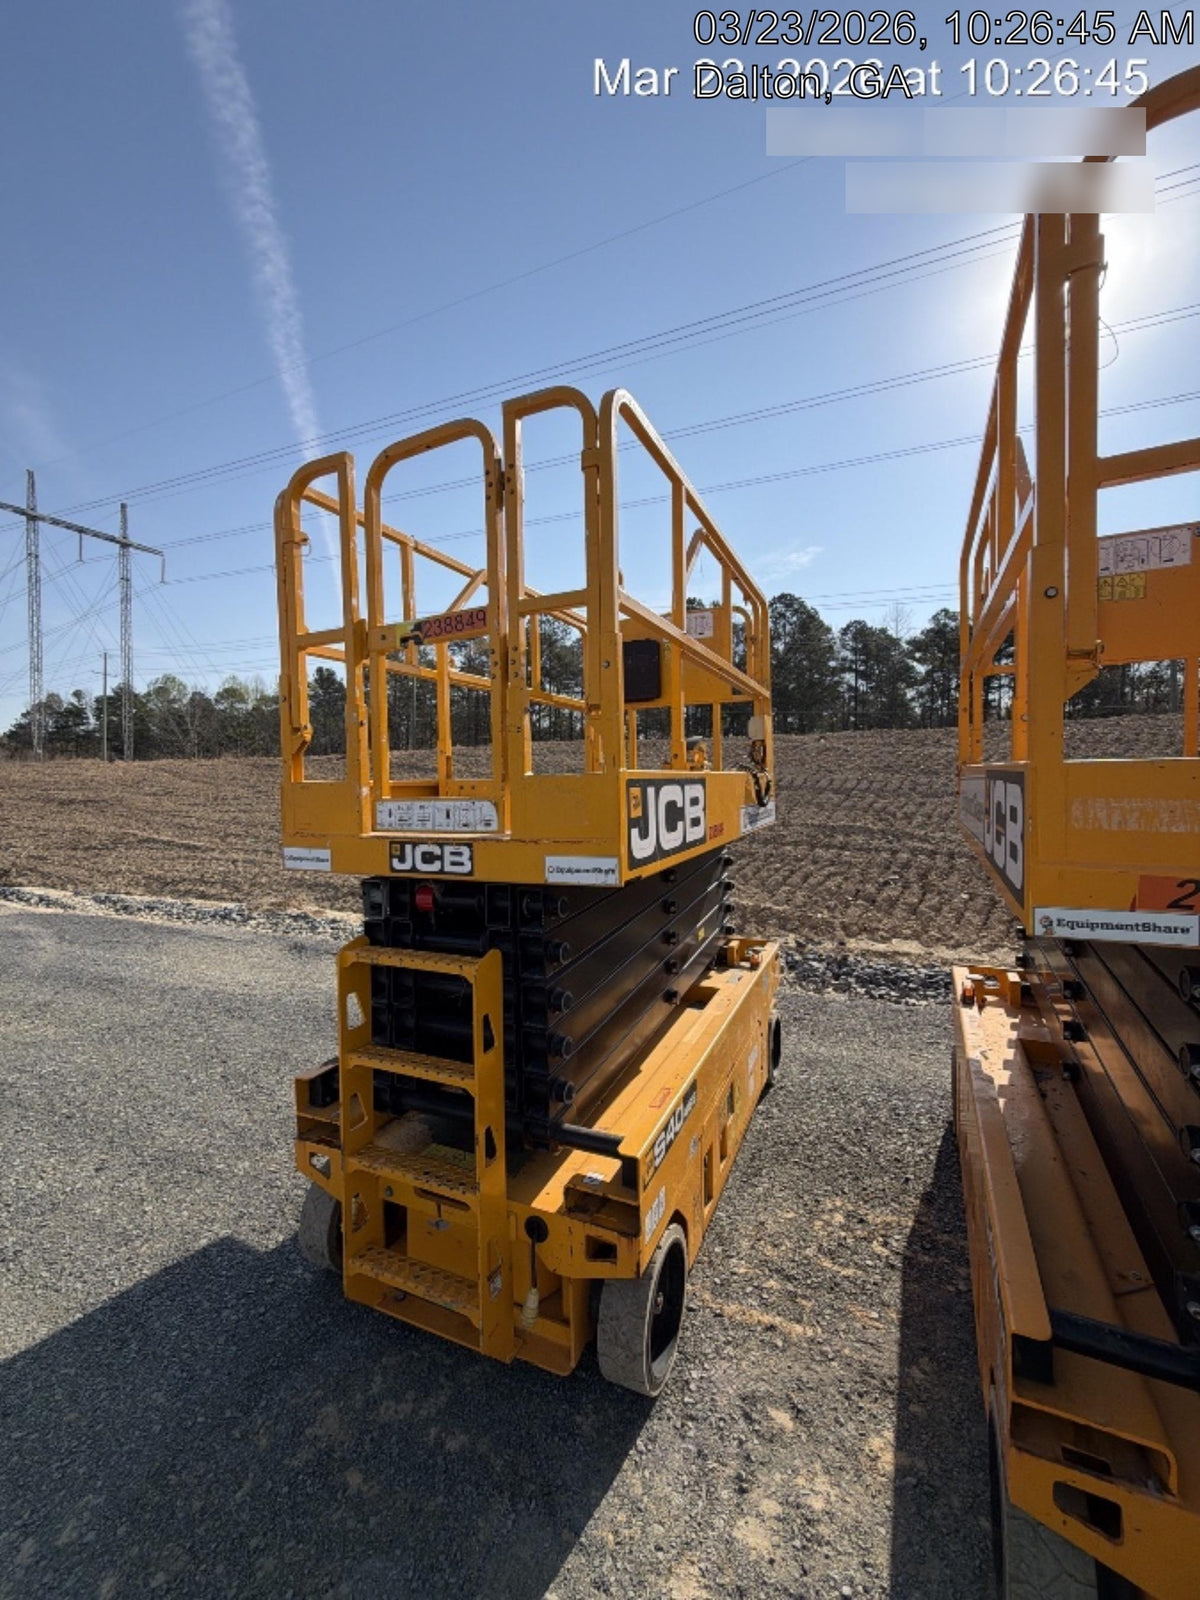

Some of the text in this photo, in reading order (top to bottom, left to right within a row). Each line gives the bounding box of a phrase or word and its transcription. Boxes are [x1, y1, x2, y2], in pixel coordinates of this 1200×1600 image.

[422, 608, 487, 638] 238849
[629, 783, 705, 859] JCB
[984, 779, 1023, 890] JCB
[391, 843, 473, 874] JCB
[1055, 917, 1193, 936] EquipmentShare
